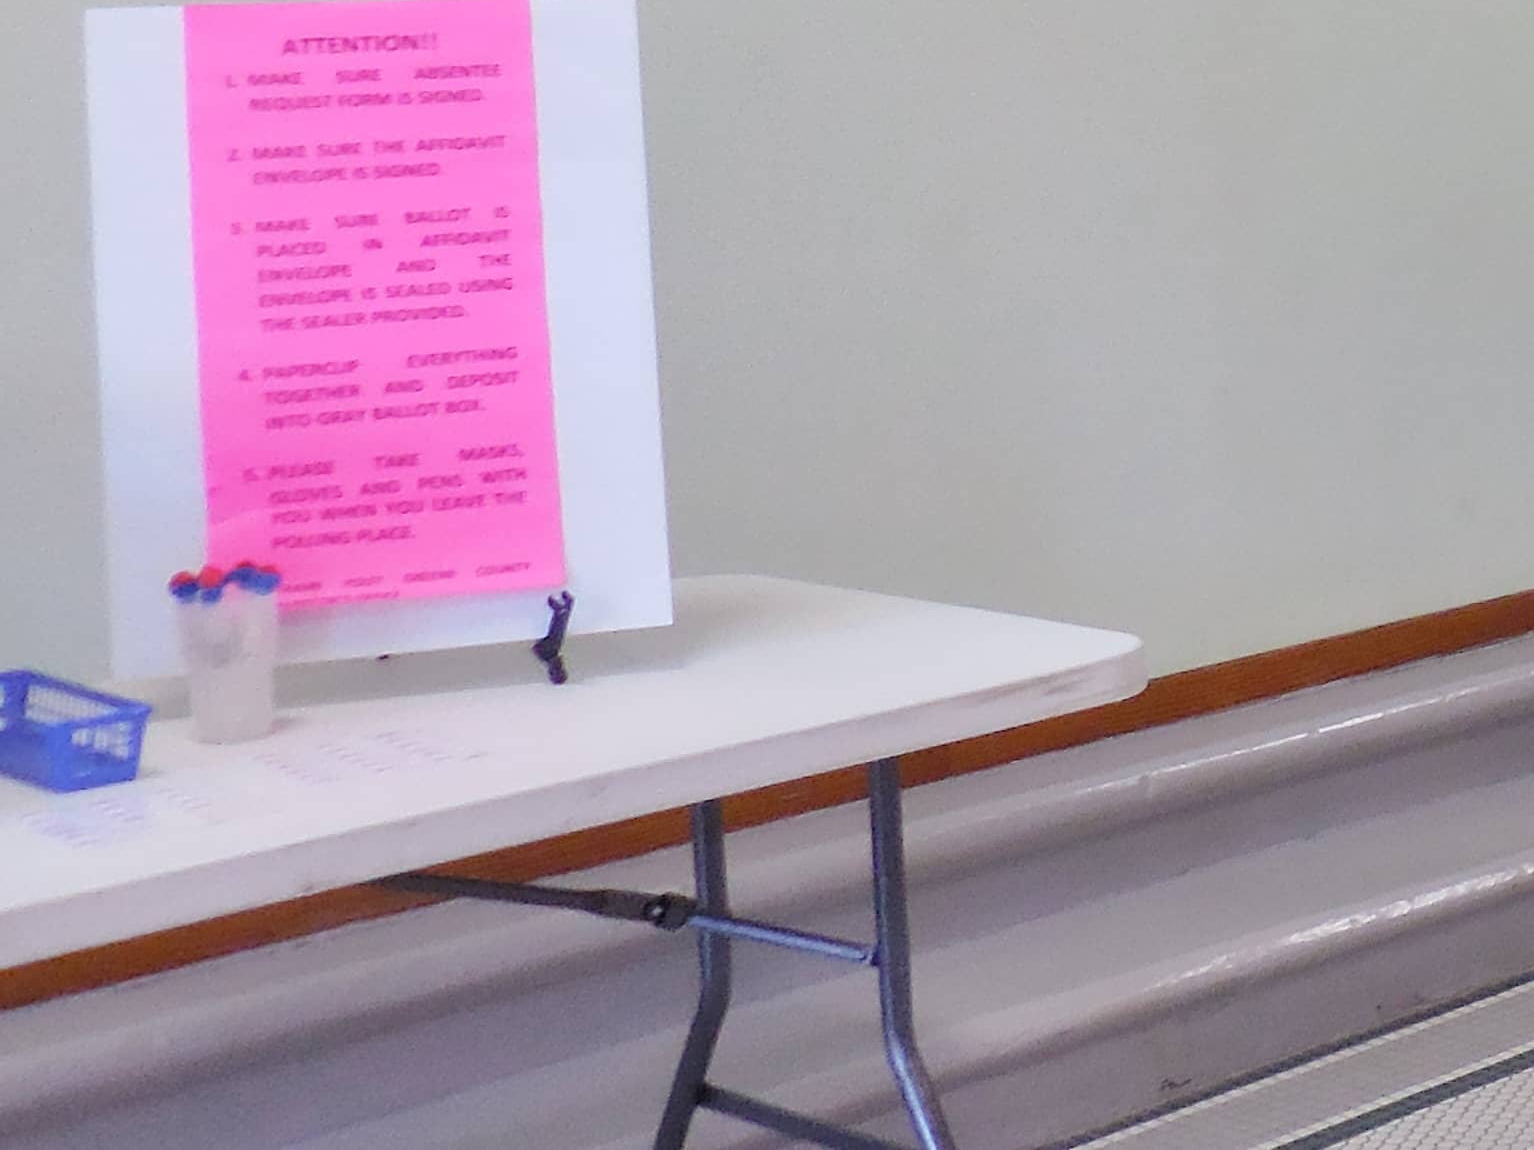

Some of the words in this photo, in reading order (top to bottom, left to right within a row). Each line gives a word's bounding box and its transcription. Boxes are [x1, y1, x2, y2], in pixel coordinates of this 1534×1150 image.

[281, 32, 438, 56] ATTENTION!!
[247, 72, 303, 86] MAKE
[336, 68, 381, 84] SURE
[414, 64, 502, 80] ABSENTEE
[249, 94, 331, 111] REQUEST
[338, 92, 393, 107] FORM
[252, 145, 308, 160] MAKE
[317, 142, 361, 157] SURE
[373, 140, 404, 154] THE
[252, 167, 347, 185] ENVELOPE
[334, 213, 379, 228] SURE
[404, 207, 471, 224] BALLOT
[256, 241, 327, 257] PLACED
[420, 229, 512, 247] AFFIDAVIT
[257, 264, 353, 283] ENVELOPE
[396, 259, 436, 273] AND
[477, 253, 512, 268] THE
[258, 289, 352, 308] ENVELOPE
[385, 282, 452, 298] SEALED
[458, 277, 513, 293] USING
[260, 318, 295, 332] THE
[301, 312, 367, 330] SEALER
[407, 347, 519, 368] EVERYTHING
[265, 384, 361, 404] TOGETHER
[384, 379, 424, 394] AND
[447, 370, 520, 390] DEPOSIT
[316, 409, 366, 425] GRAY
[373, 402, 440, 420] BALLOT
[267, 461, 335, 480] PLEASE
[374, 453, 421, 469] TAKE
[269, 485, 343, 505] GLOVES
[359, 480, 401, 496] AND
[417, 474, 464, 490] PENS
[480, 467, 528, 484] WITH
[271, 509, 312, 524] YOU
[319, 504, 377, 521] WHEN
[386, 499, 424, 515] YOU
[432, 494, 486, 511] LEAVE
[271, 531, 351, 548] POLLING
